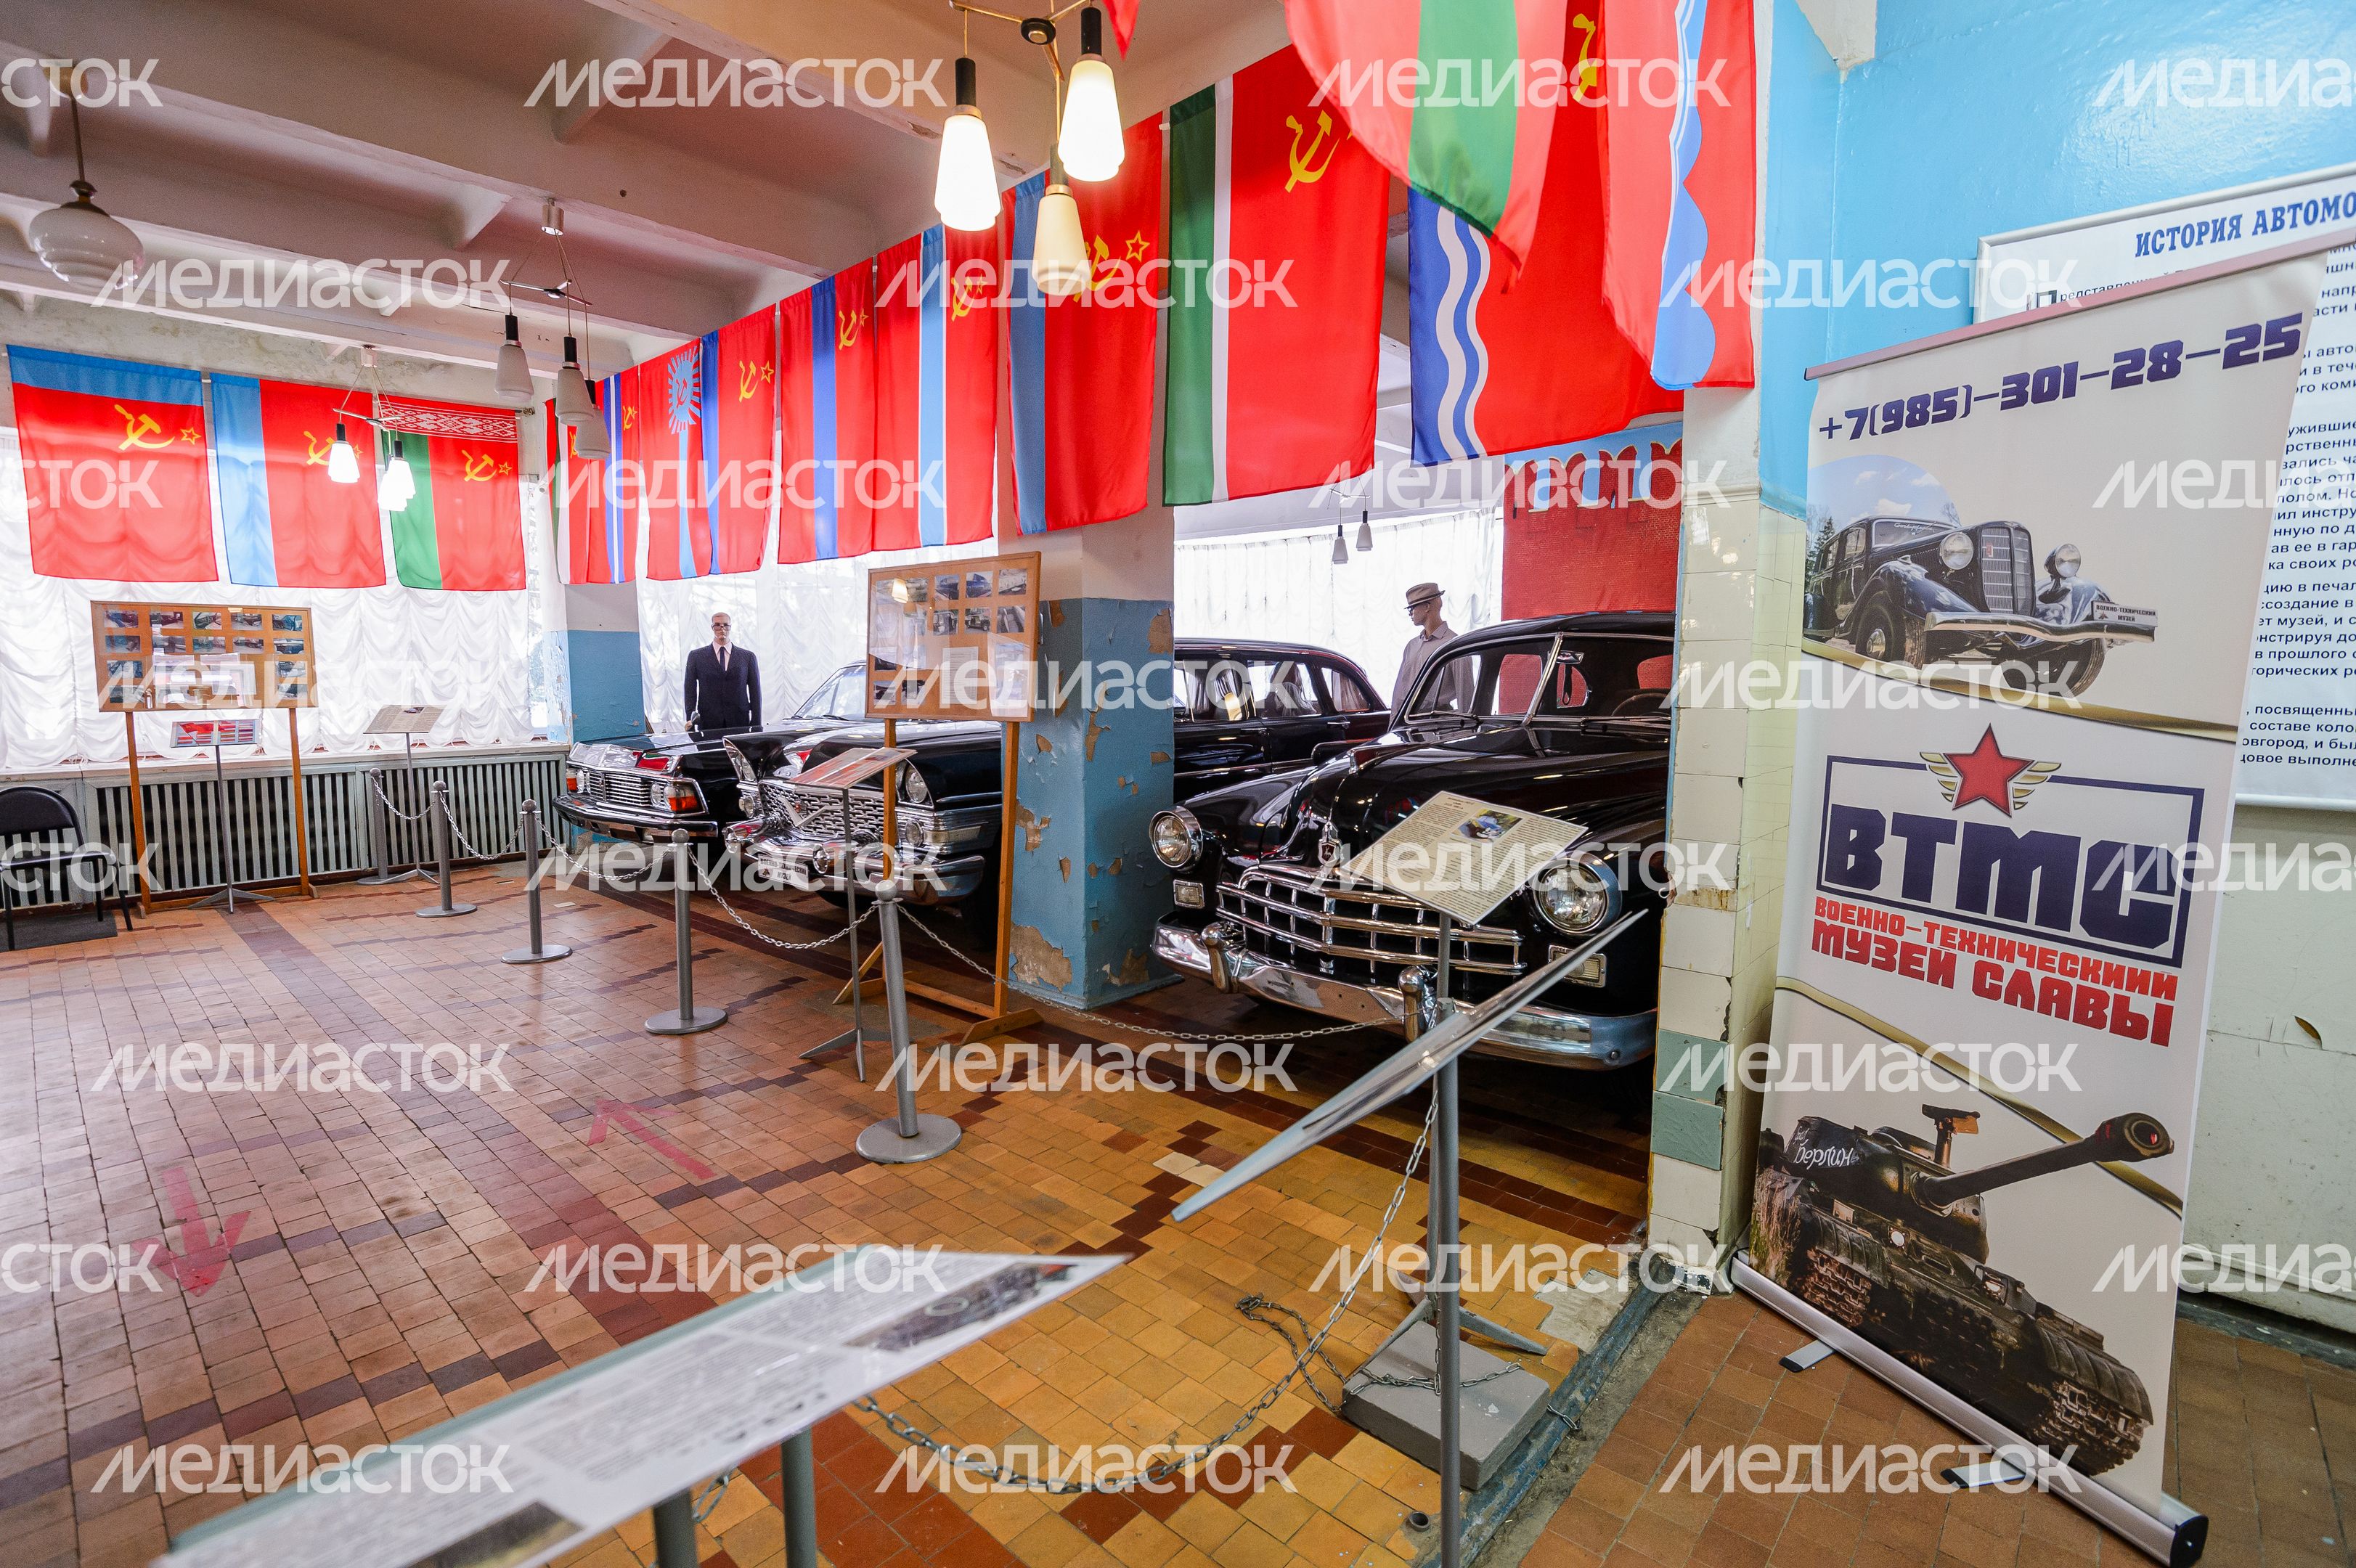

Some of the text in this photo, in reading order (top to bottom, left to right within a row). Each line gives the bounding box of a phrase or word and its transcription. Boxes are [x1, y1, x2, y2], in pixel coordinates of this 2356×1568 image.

[2135, 192, 2356, 257] ИСТОРИЯ АВТОМО
[2328, 362, 2356, 372] теч
[2274, 528, 2315, 539] нную
[2320, 525, 2339, 534] по
[2294, 543, 2312, 552] ее
[2318, 542, 2326, 552] в
[2289, 559, 2336, 570] своих
[2298, 584, 2307, 592] в
[2277, 614, 2328, 629] музей,
[2257, 634, 2332, 645] нстрируя
[2268, 650, 2347, 661] прошлого
[2249, 722, 2356, 733] составе коло
[1824, 803, 2179, 949] ВТМС
[1811, 918, 2174, 1048] МУЗЕЙ СЛАВЫ
